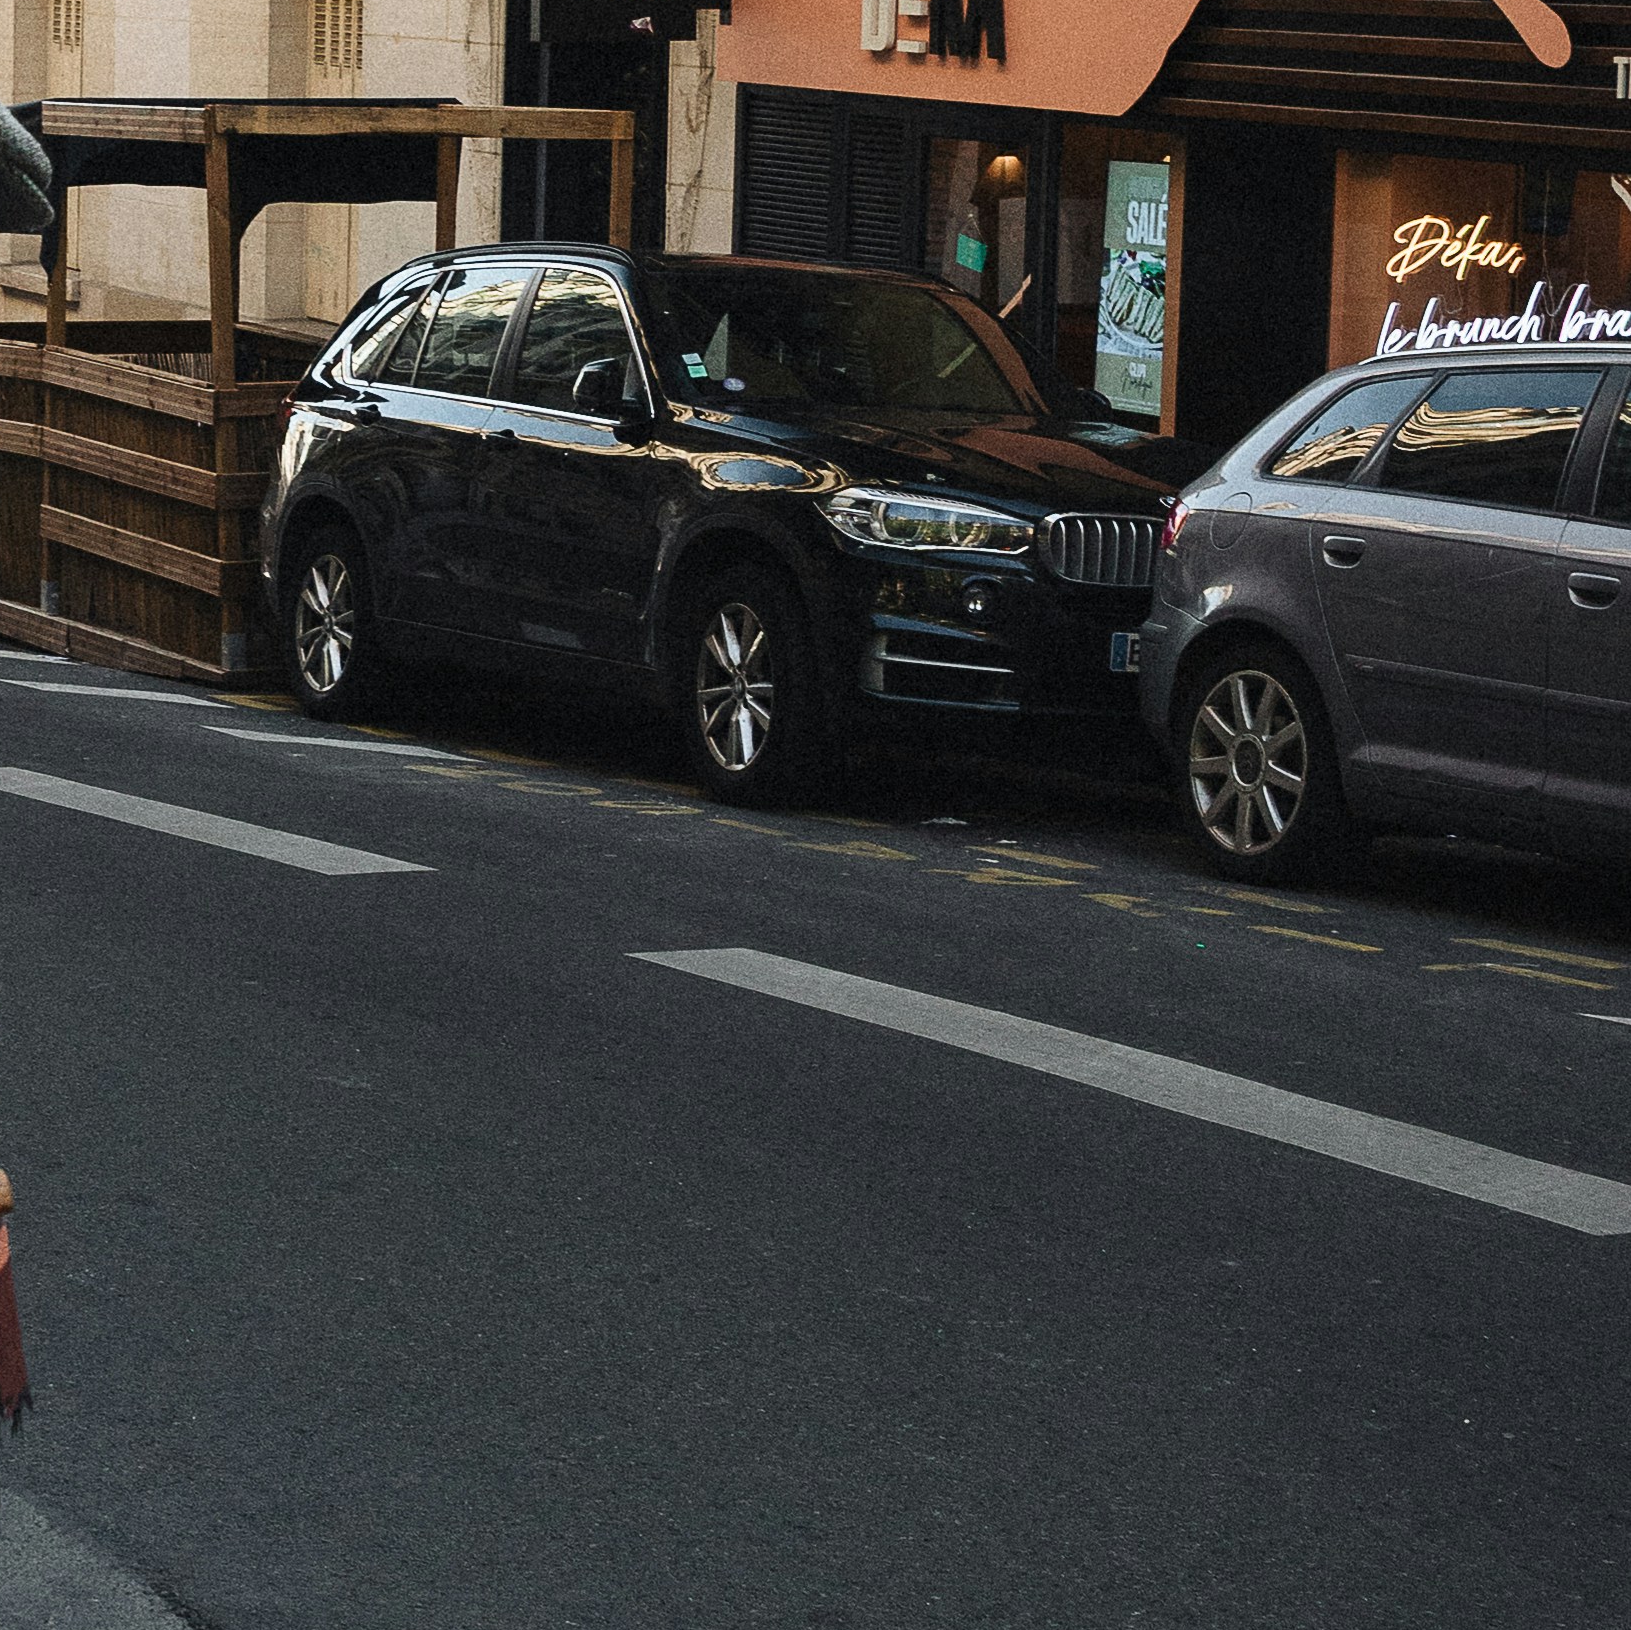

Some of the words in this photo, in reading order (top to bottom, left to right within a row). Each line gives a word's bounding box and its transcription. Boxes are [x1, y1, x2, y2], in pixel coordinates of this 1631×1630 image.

[1126, 193, 1169, 246] SALÉ
[1376, 301, 1416, 355] le
[1416, 281, 1546, 349] brunch
